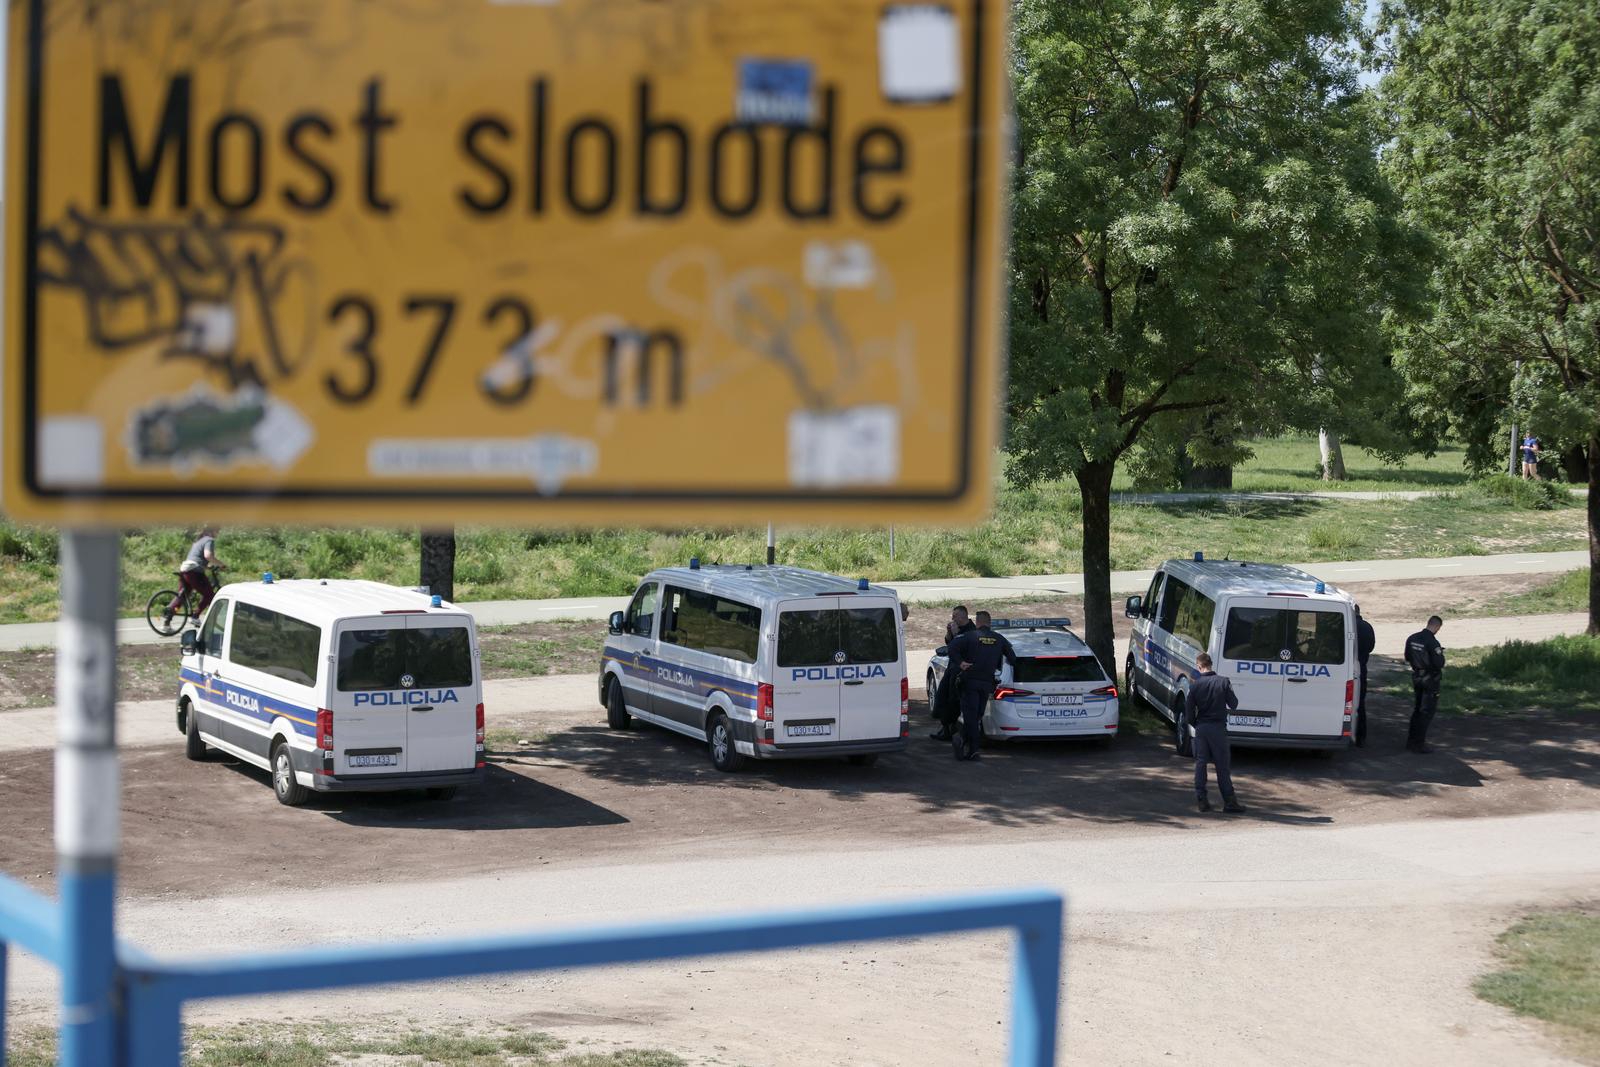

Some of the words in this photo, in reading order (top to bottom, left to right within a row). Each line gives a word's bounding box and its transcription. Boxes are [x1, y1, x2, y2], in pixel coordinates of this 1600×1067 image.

[98, 73, 397, 214] Most
[457, 75, 908, 223] slobode
[324, 294, 536, 408] 373
[604, 326, 686, 409] m
[1011, 619, 1043, 627] POLICIJA
[657, 666, 694, 688] POLICIJA
[792, 665, 886, 681] POLICIJA
[1237, 661, 1331, 677] POLICIJA
[226, 689, 260, 714] POLICIJA
[354, 689, 459, 707] POLICIJA
[1036, 709, 1088, 717] POLICIJA
